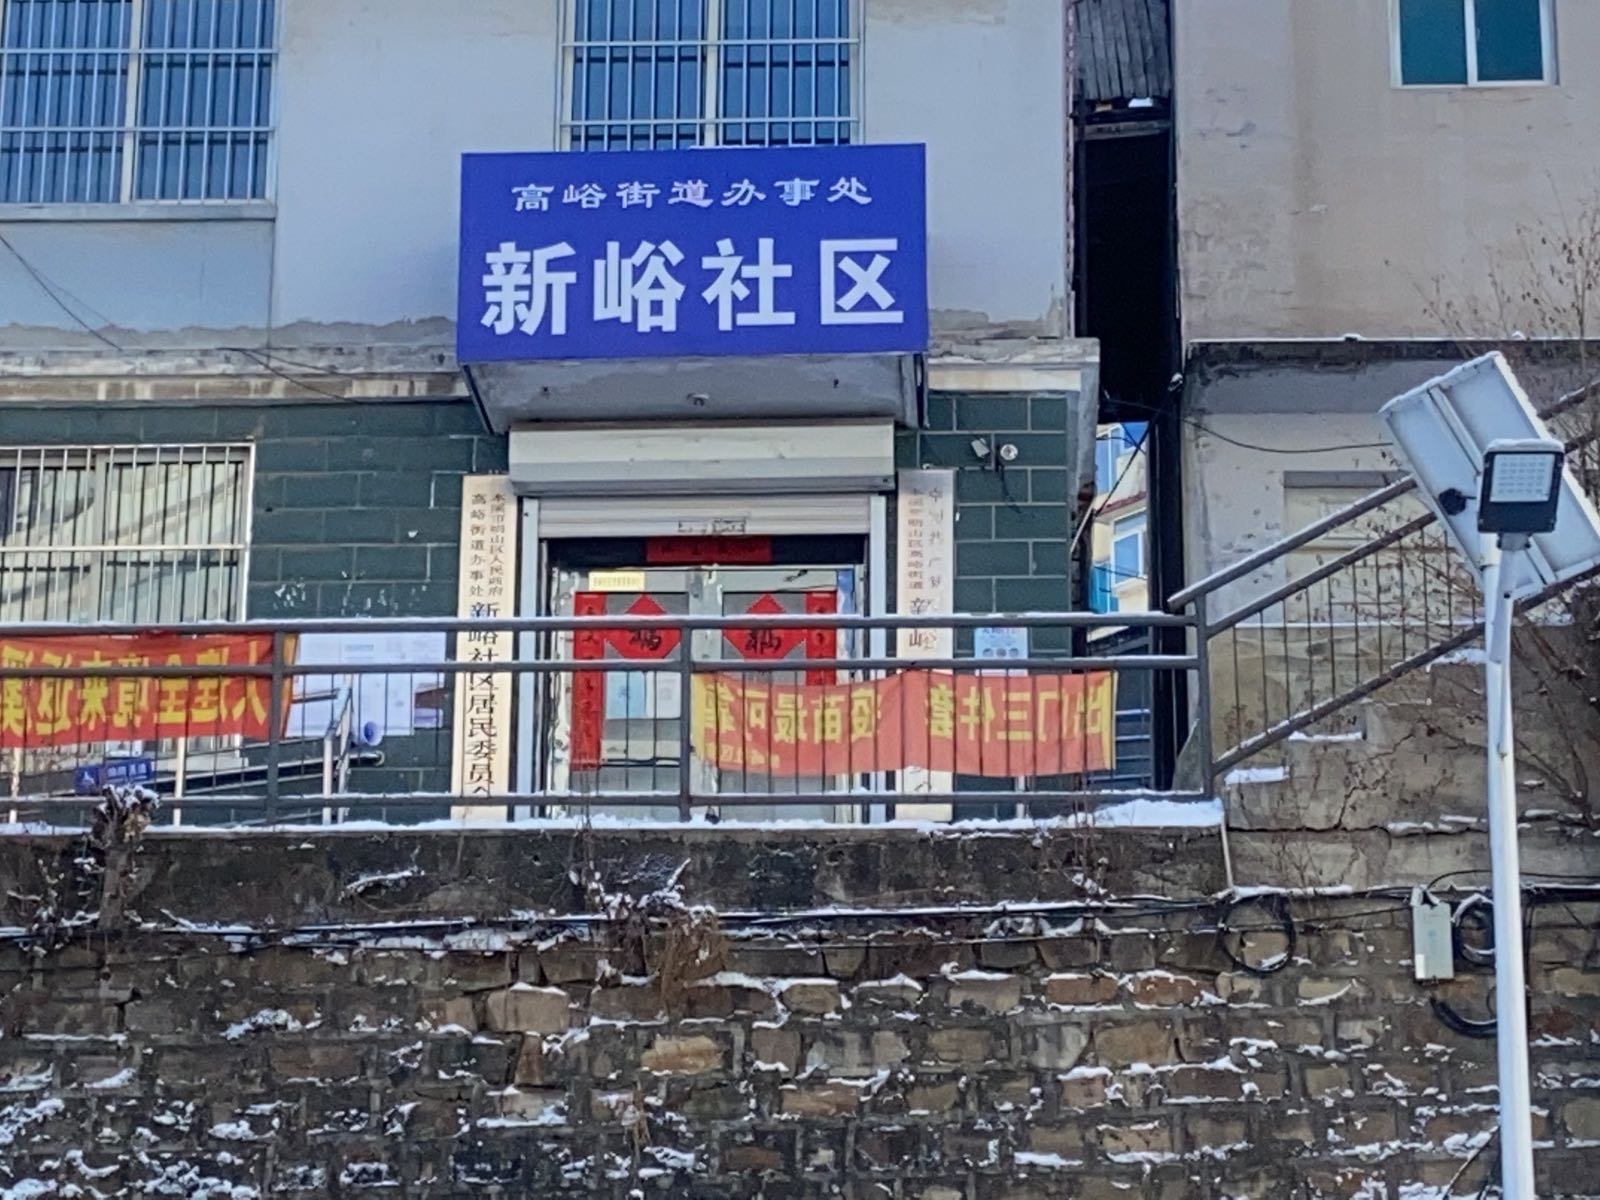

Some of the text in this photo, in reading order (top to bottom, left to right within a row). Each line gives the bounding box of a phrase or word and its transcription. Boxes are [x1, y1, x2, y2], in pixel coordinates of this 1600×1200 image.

[511, 177, 873, 213] 高峪街道办事处
[481, 238, 904, 336] 新峪社区
[465, 601, 501, 797] 新峪社区居民委员
